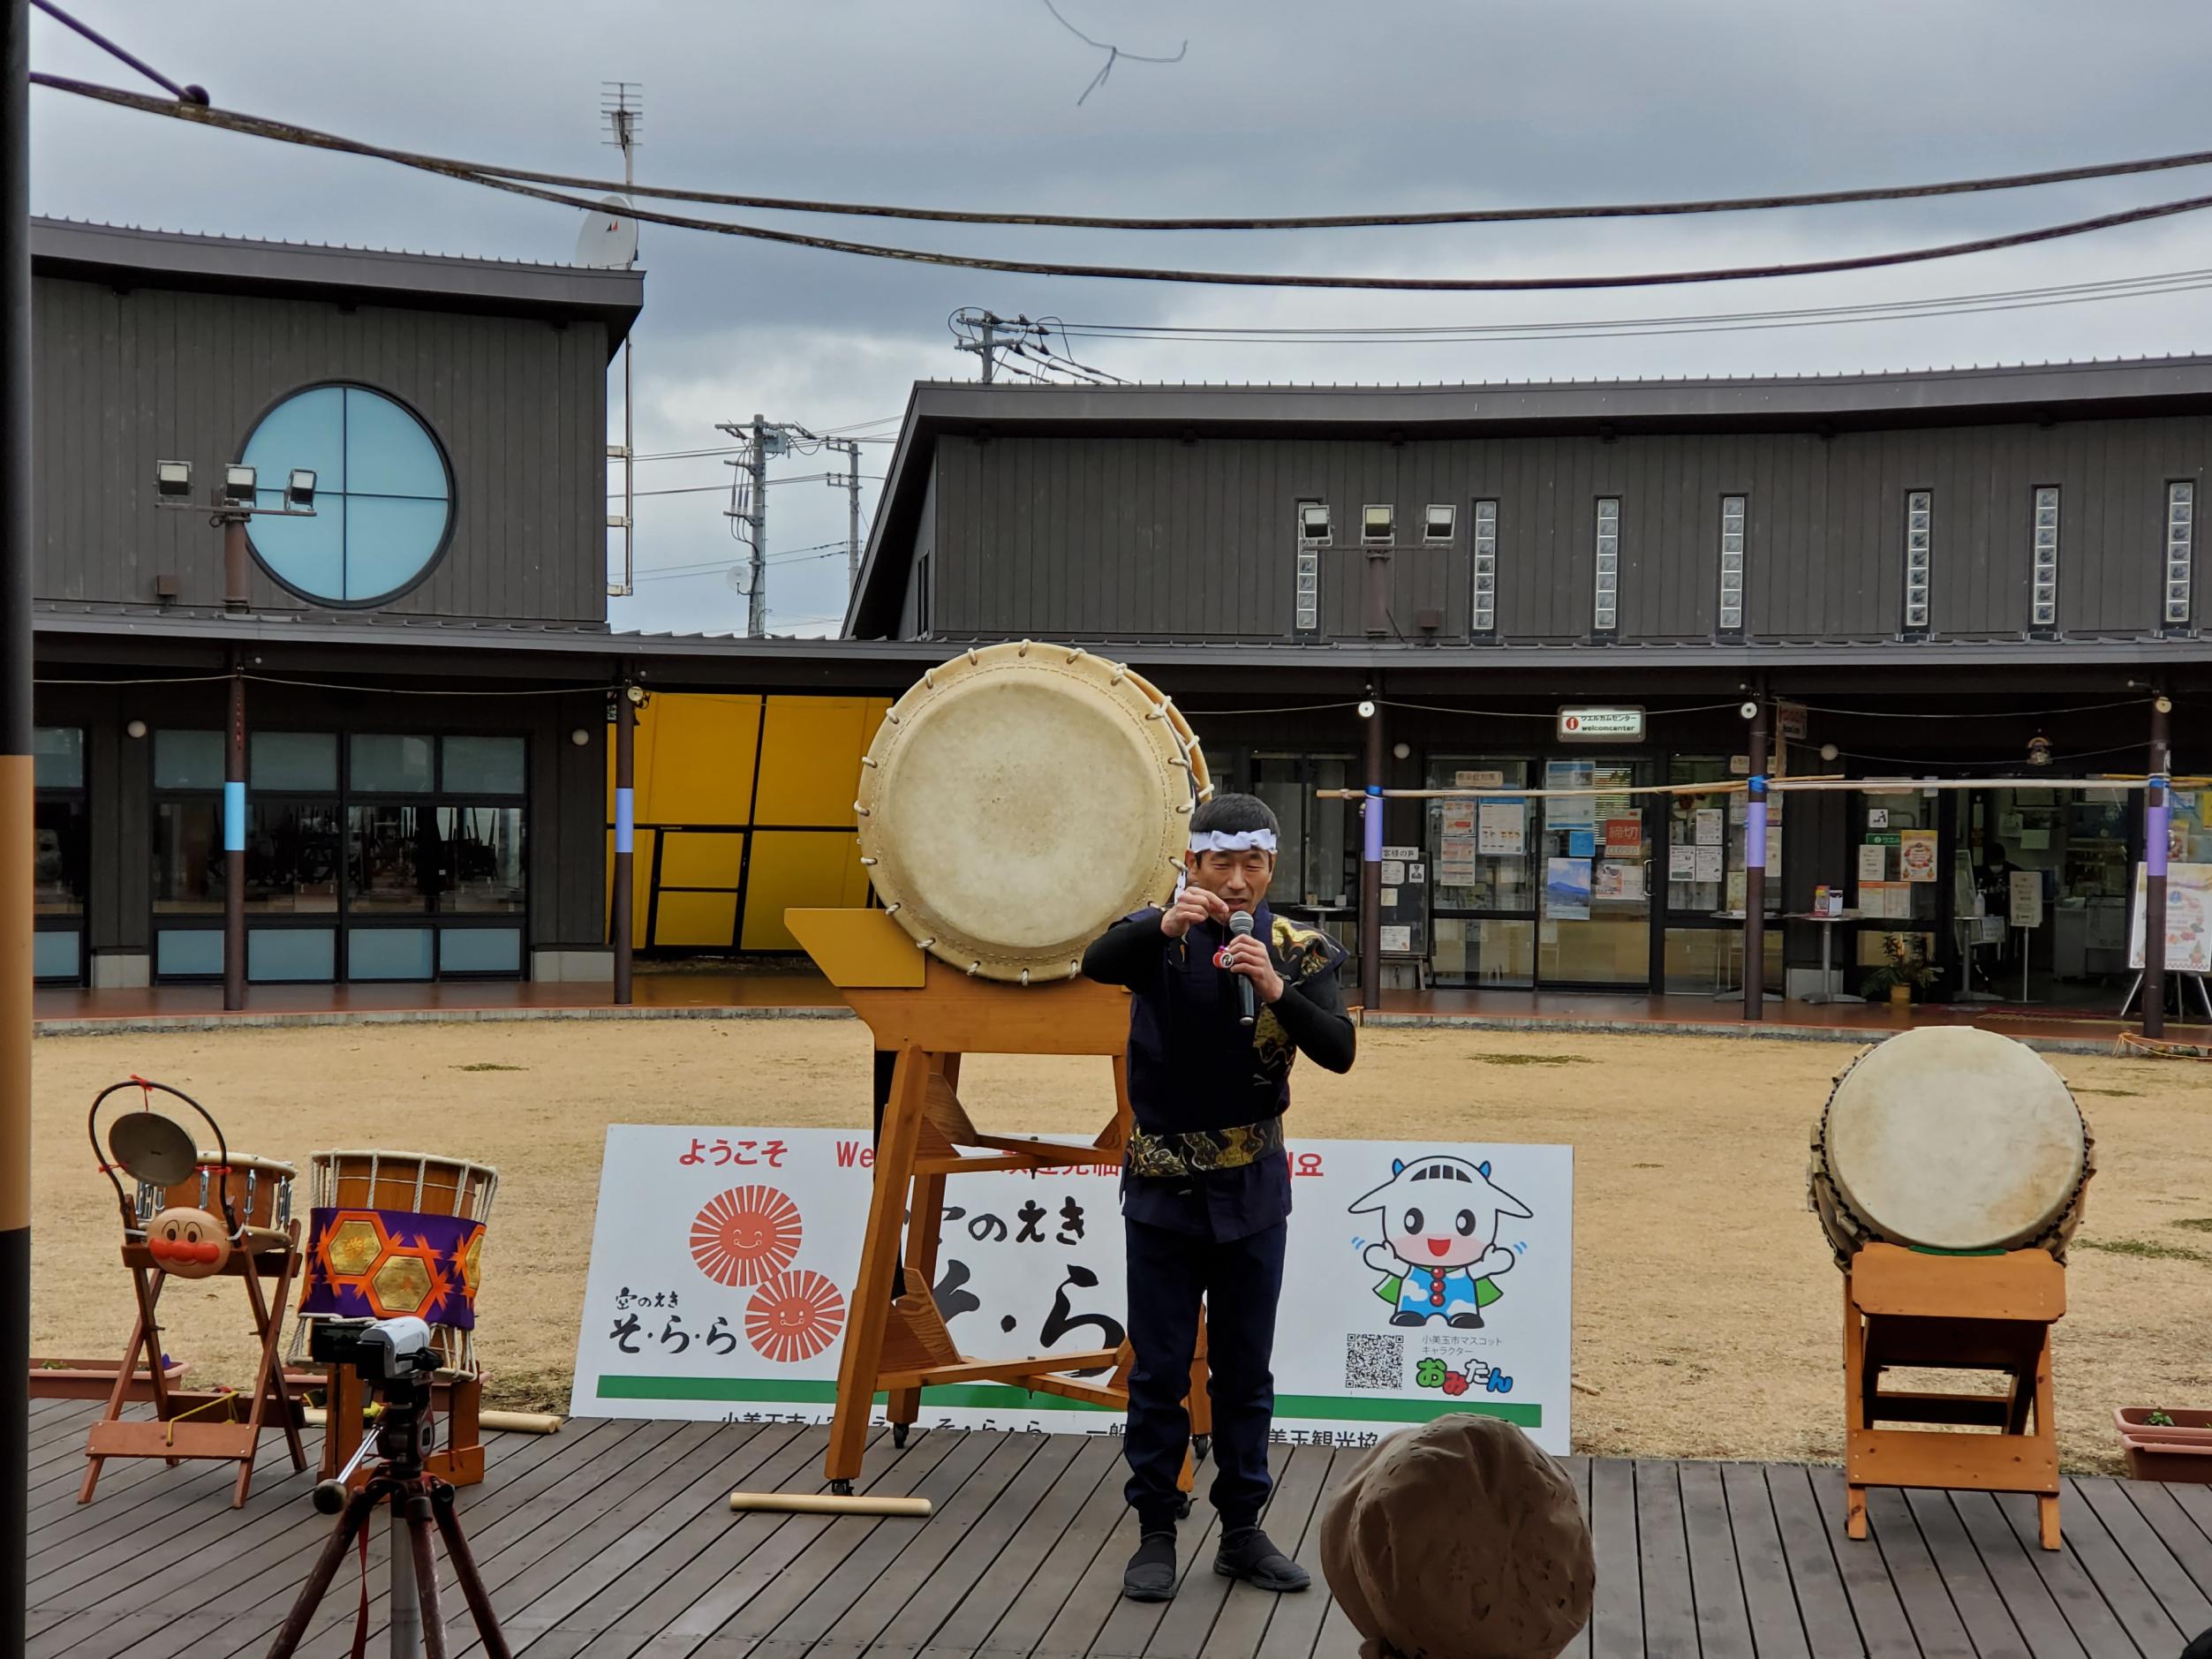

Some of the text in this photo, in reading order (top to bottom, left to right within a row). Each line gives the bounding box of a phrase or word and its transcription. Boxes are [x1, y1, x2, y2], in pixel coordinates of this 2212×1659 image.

[679, 1138, 788, 1167] ようこそ
[836, 1141, 874, 1167] We
[904, 1195, 1084, 1246] のえき
[615, 1286, 678, 1310] 空のえき
[1422, 1335, 1502, 1346] 小美玉市マスコット
[1422, 1346, 1473, 1355] キャラクター
[1416, 1357, 1513, 1396] おみたん
